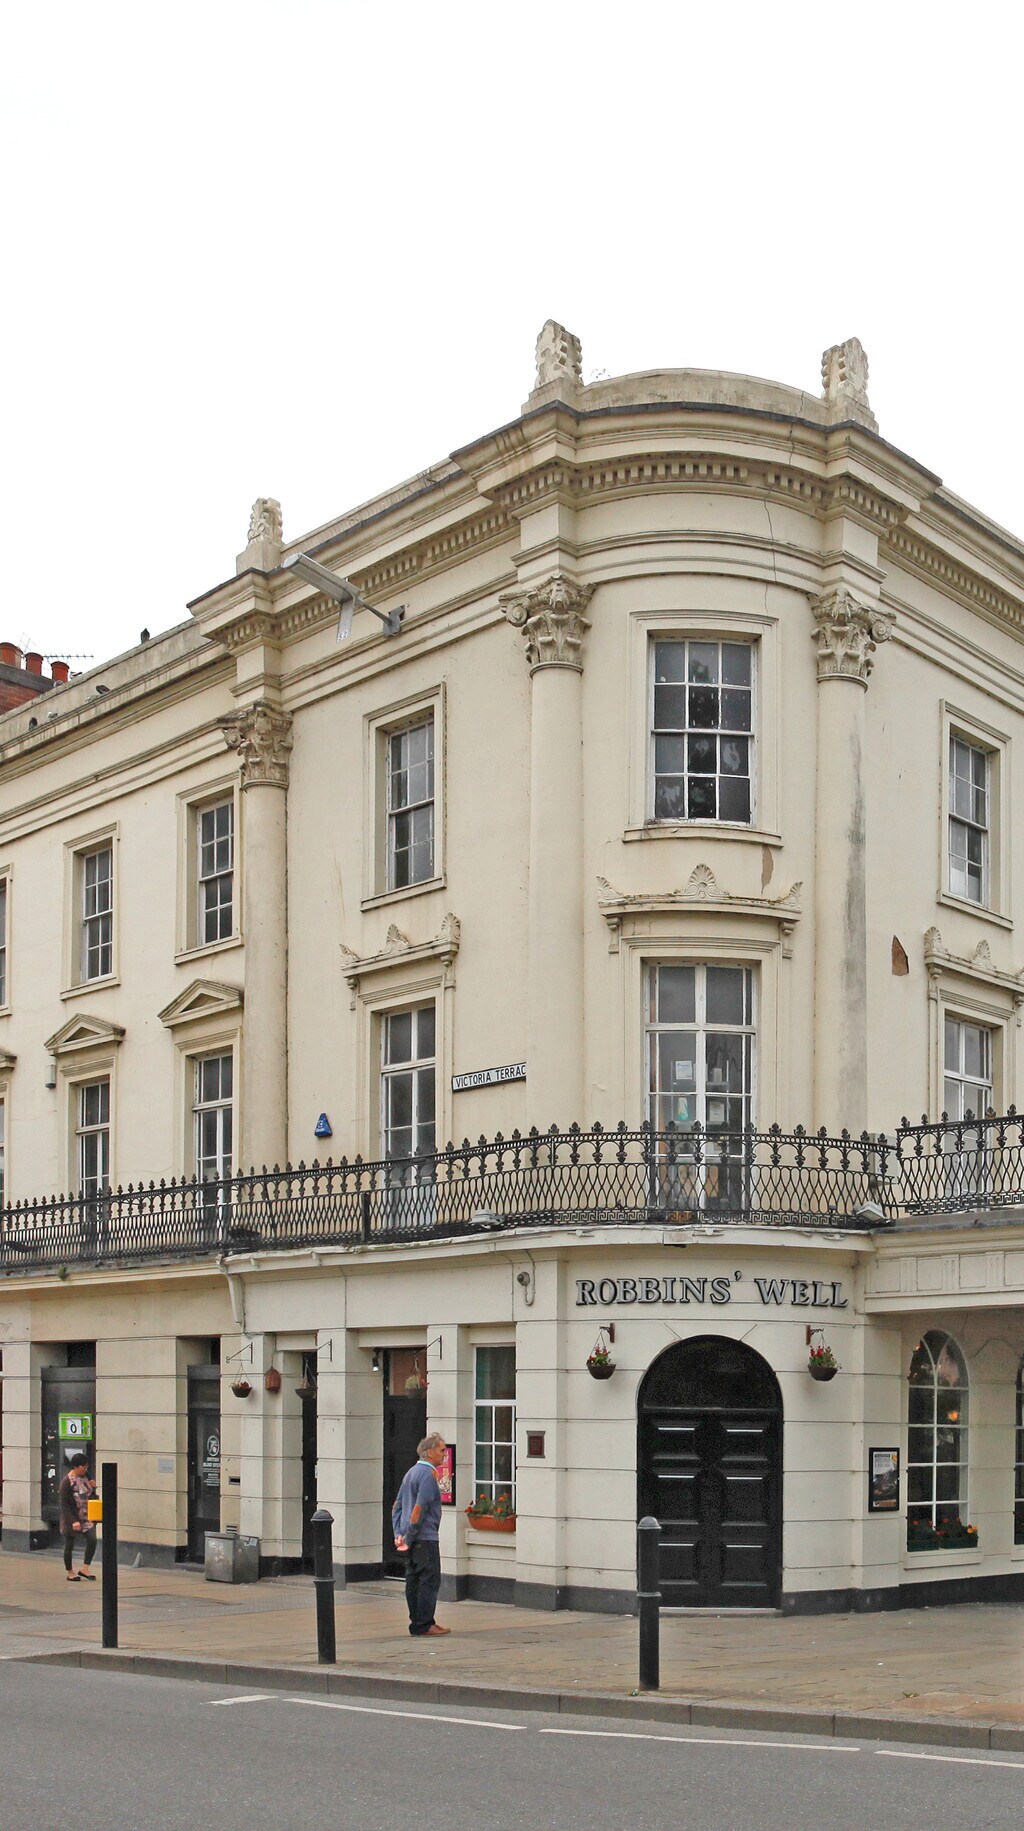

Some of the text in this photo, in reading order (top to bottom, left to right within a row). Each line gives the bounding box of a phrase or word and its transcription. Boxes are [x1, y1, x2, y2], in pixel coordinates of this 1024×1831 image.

[456, 1065, 526, 1088] VICTORIA TERRAC
[575, 1270, 849, 1308] ROBBINS' WELL
